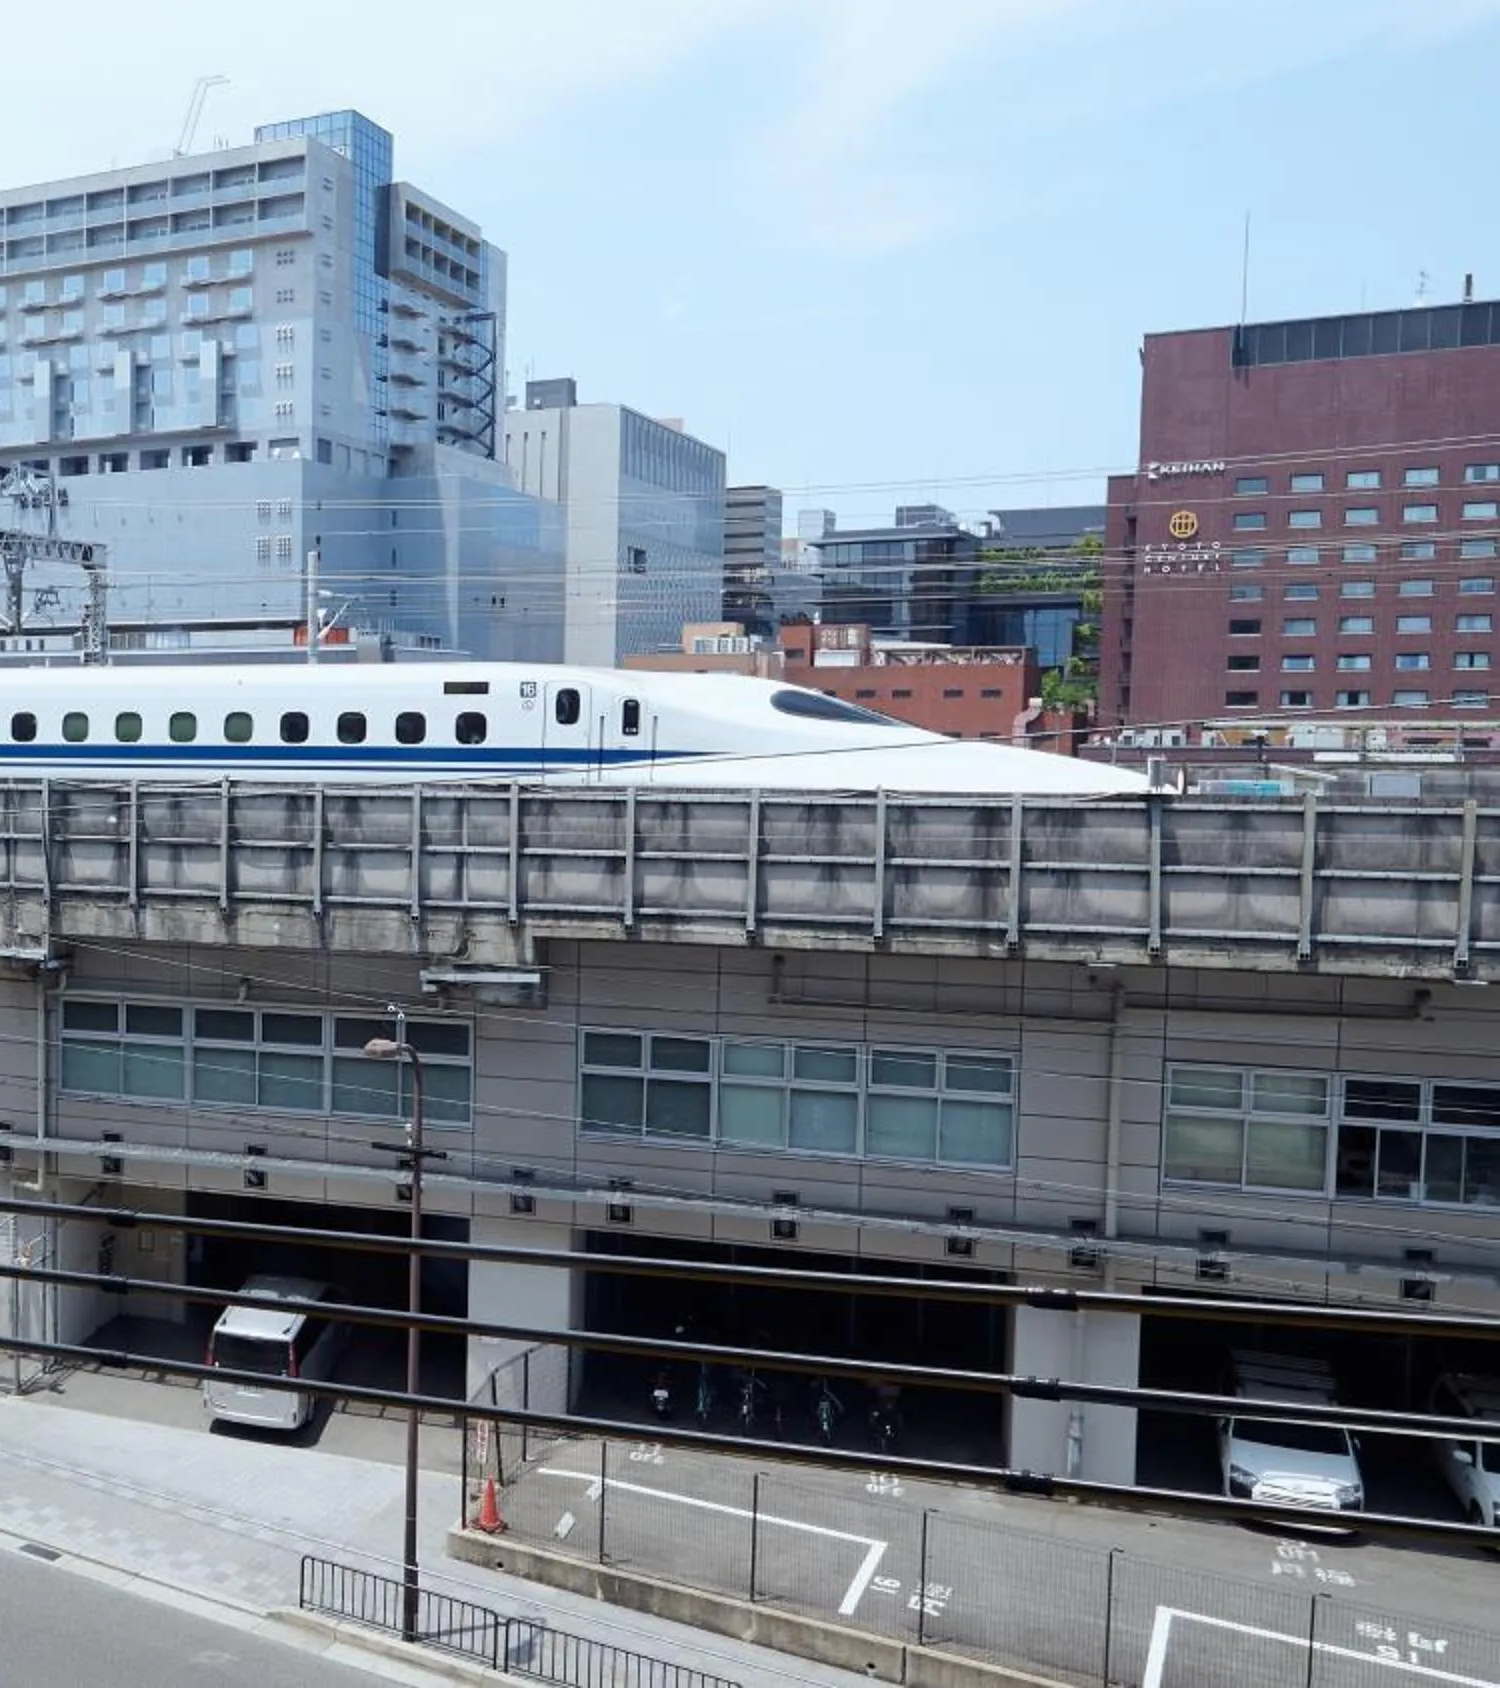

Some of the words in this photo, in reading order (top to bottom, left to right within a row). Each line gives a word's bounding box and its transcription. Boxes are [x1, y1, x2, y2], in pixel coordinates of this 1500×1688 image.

[1160, 462, 1225, 474] KEIHAN
[1143, 563, 1220, 574] HOTEL
[522, 683, 535, 697] 16
